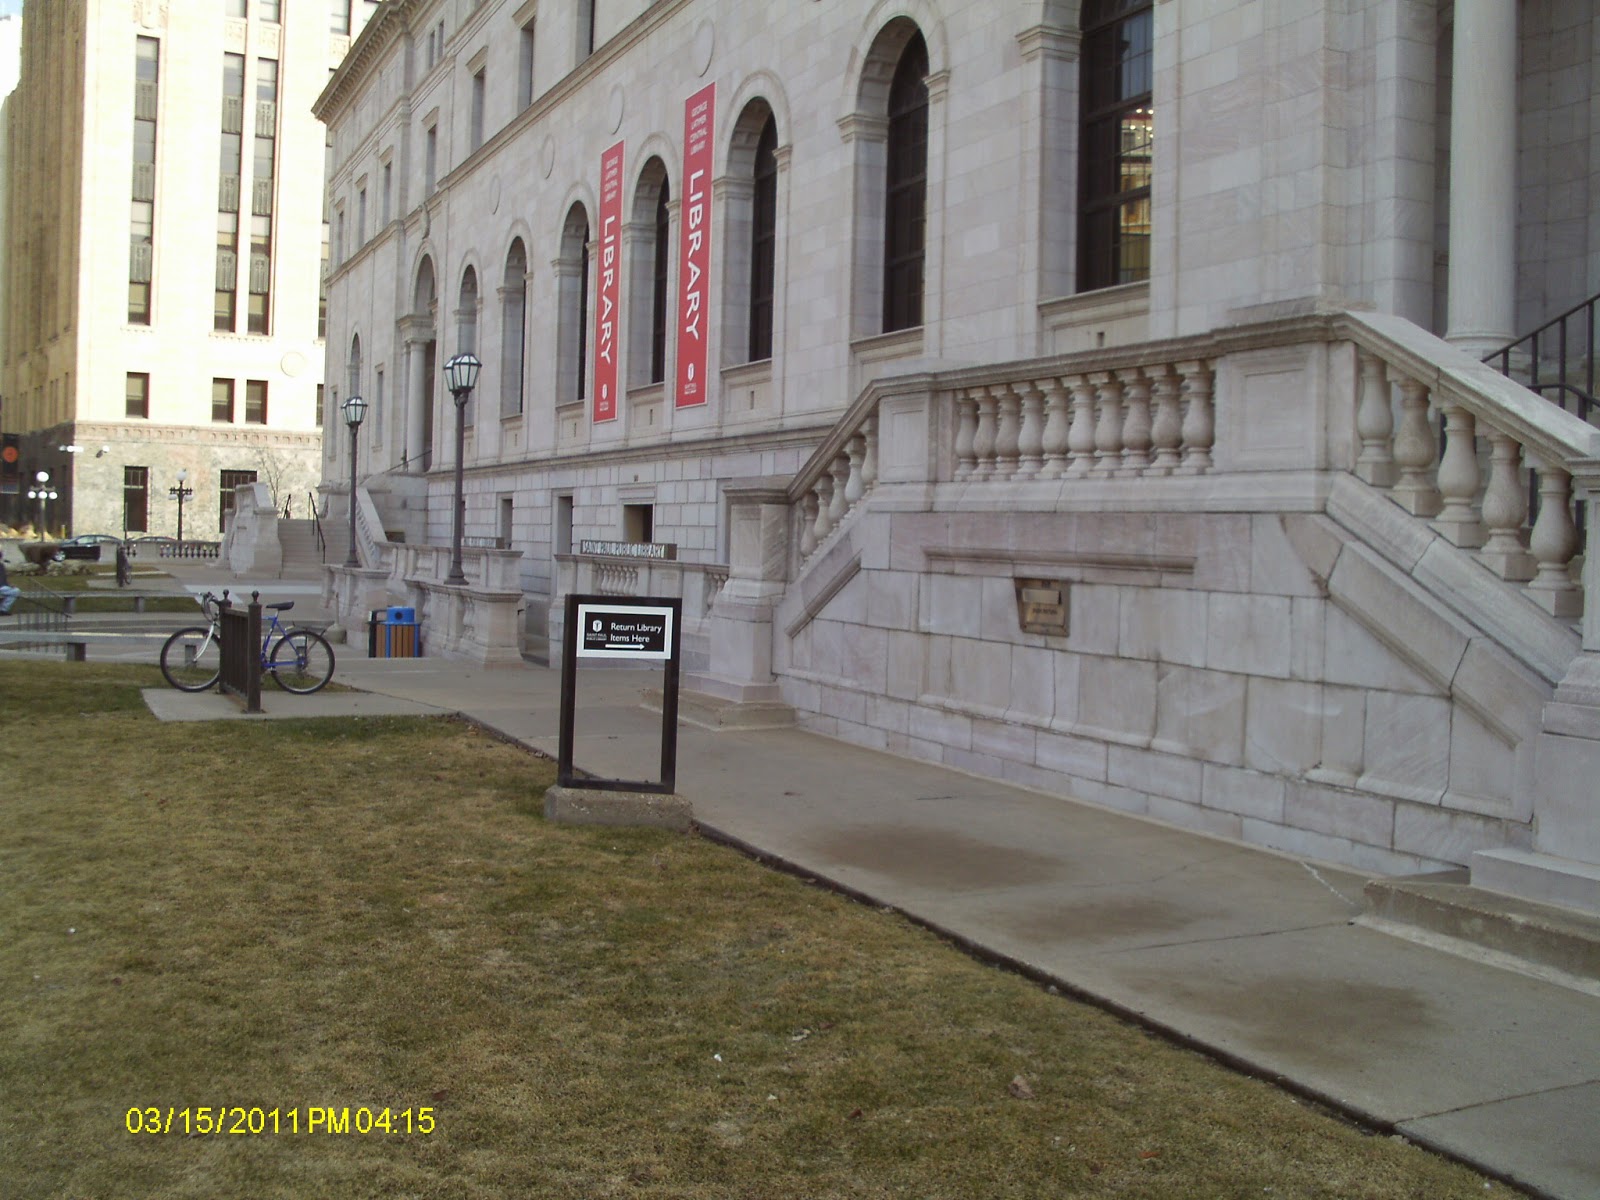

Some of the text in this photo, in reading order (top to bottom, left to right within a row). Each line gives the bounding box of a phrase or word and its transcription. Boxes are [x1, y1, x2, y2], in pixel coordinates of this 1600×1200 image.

[600, 215, 616, 365] LIBRARY
[685, 168, 704, 341] LIBRARY
[610, 633, 630, 642] Items
[631, 634, 650, 643] Here
[611, 622, 662, 634] Return Library
